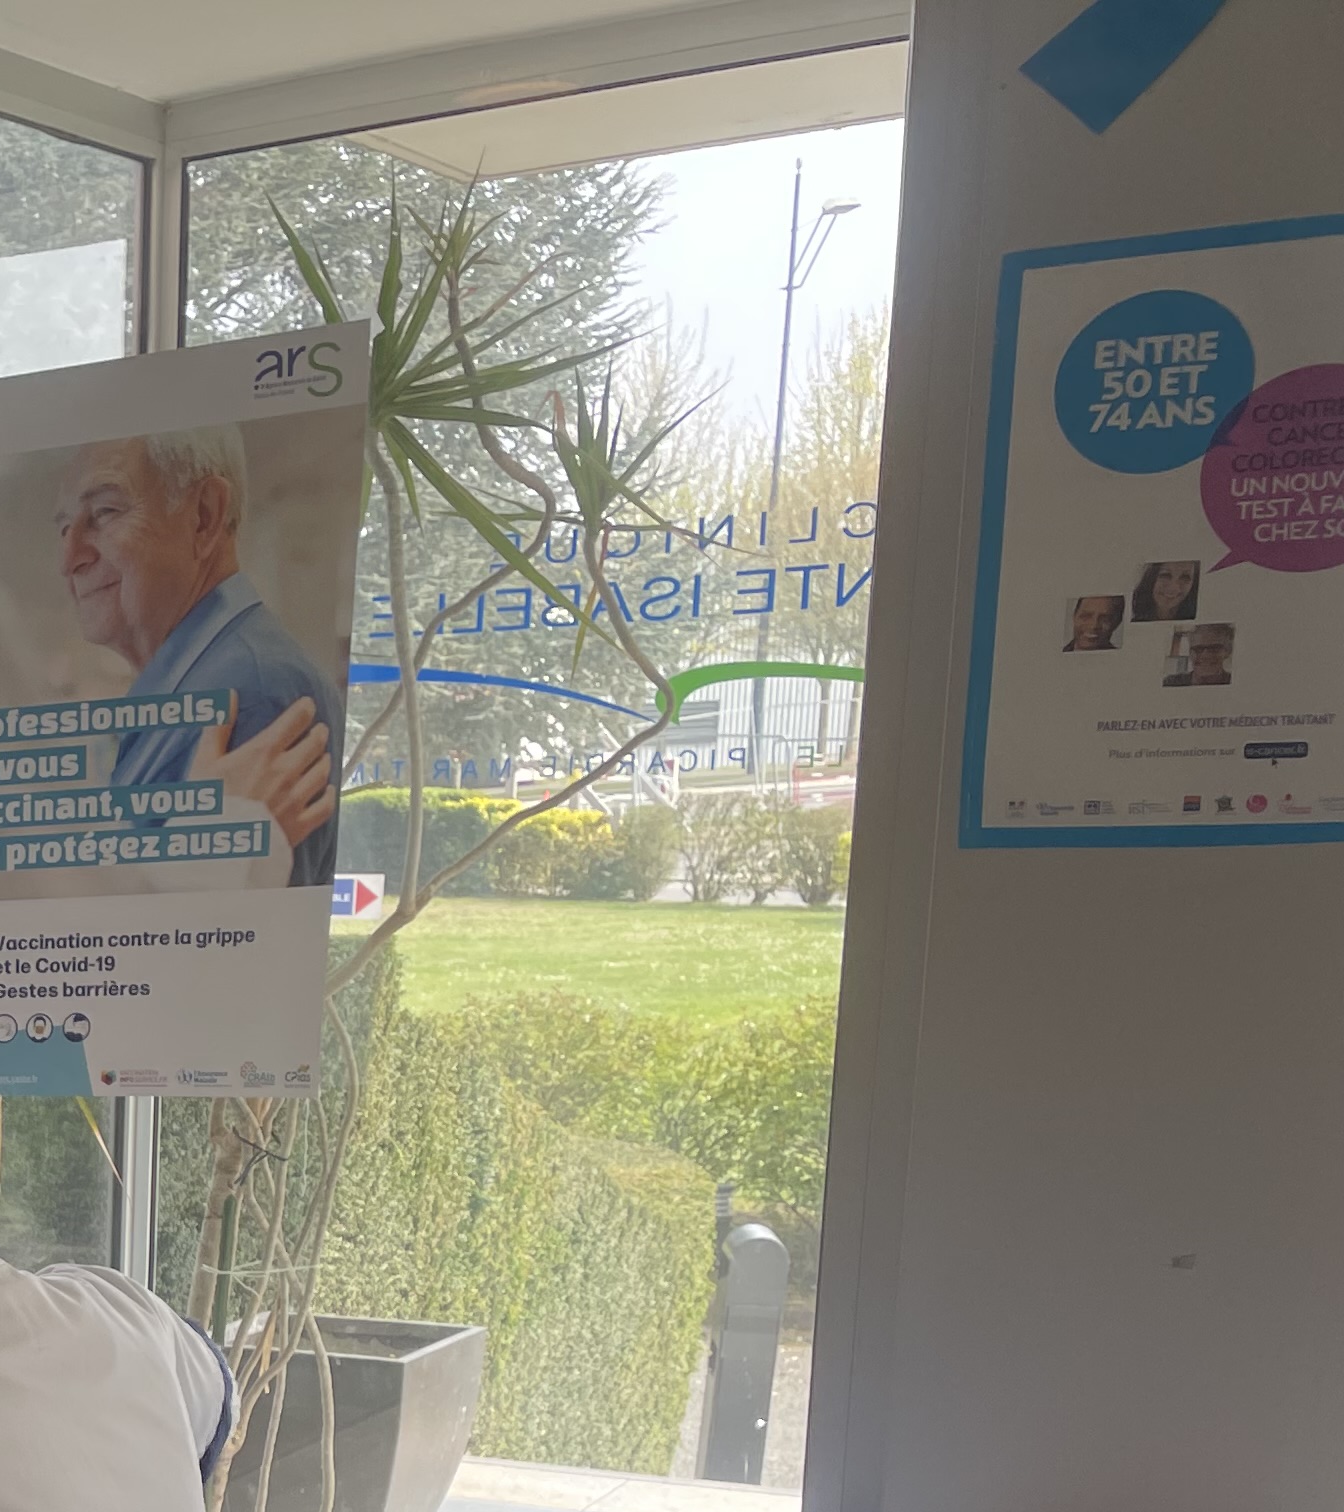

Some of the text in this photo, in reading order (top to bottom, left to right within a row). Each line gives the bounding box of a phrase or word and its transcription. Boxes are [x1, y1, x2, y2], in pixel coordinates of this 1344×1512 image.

[1093, 330, 1220, 370] ENTRE
[254, 341, 343, 398] ars
[1100, 364, 1210, 402] 50 ET
[1087, 396, 1217, 434] 74 ANS
[1230, 476, 1267, 498] UN
[1236, 497, 1295, 520] TEST
[1296, 491, 1315, 516] À
[1252, 519, 1319, 543] CHEZ
[1097, 712, 1337, 732] PARLEZ-EN AVEC VOTRE MÉDECIN TRAITANT
[1108, 747, 1132, 759] Plus
[1134, 745, 1217, 758] d'informations
[1219, 747, 1236, 757] sur
[130, 786, 217, 816] vous
[6, 832, 161, 871] protégez
[167, 822, 264, 858] aussi
[107, 930, 172, 950] contre
[174, 929, 194, 946] la
[195, 927, 256, 950] grippe
[15, 957, 33, 975] le
[35, 954, 117, 976] Covid-19
[61, 979, 152, 999] barrières
